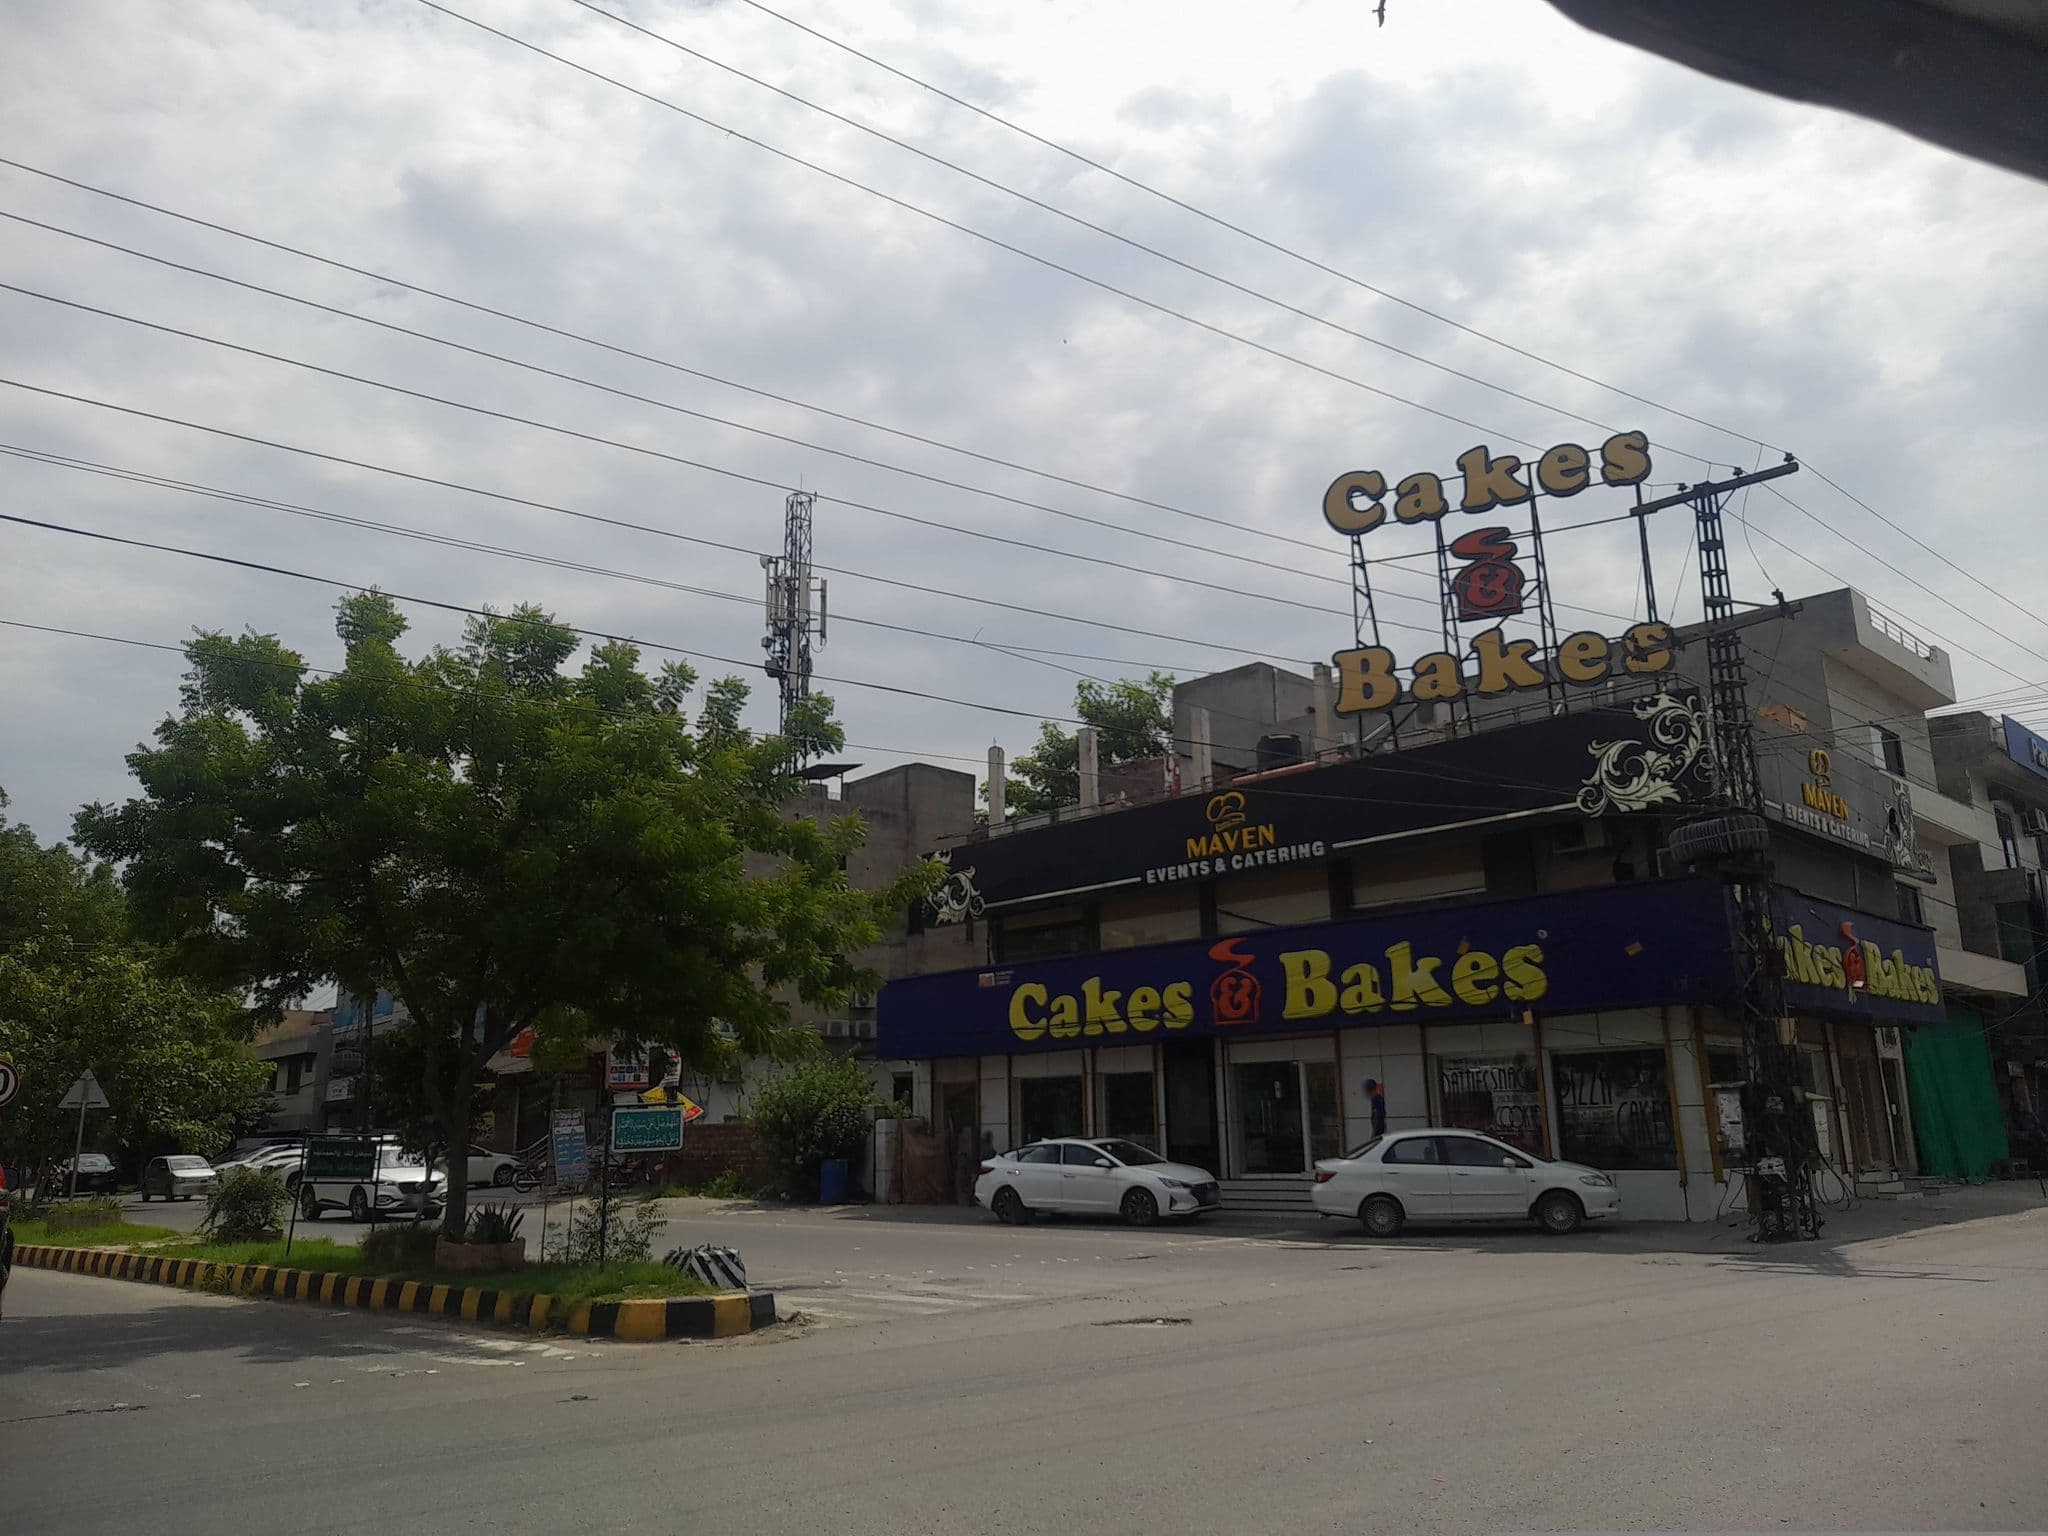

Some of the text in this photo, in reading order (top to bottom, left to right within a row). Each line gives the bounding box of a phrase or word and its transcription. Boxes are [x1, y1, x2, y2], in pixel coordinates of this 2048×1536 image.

[1323, 430, 1652, 535] Cakes
[1332, 620, 1677, 718] Bakes
[1785, 803, 1821, 833] EVENTS
[1828, 819, 1870, 849] CATERING
[1801, 783, 1850, 821] MAVEN
[1145, 841, 1327, 885] EVENTS & CATERING
[1186, 823, 1276, 859] MAVEN
[1008, 976, 1194, 1041] Cakes
[1278, 940, 1548, 1021] Bakes
[1861, 939, 1940, 1006] Bakes
